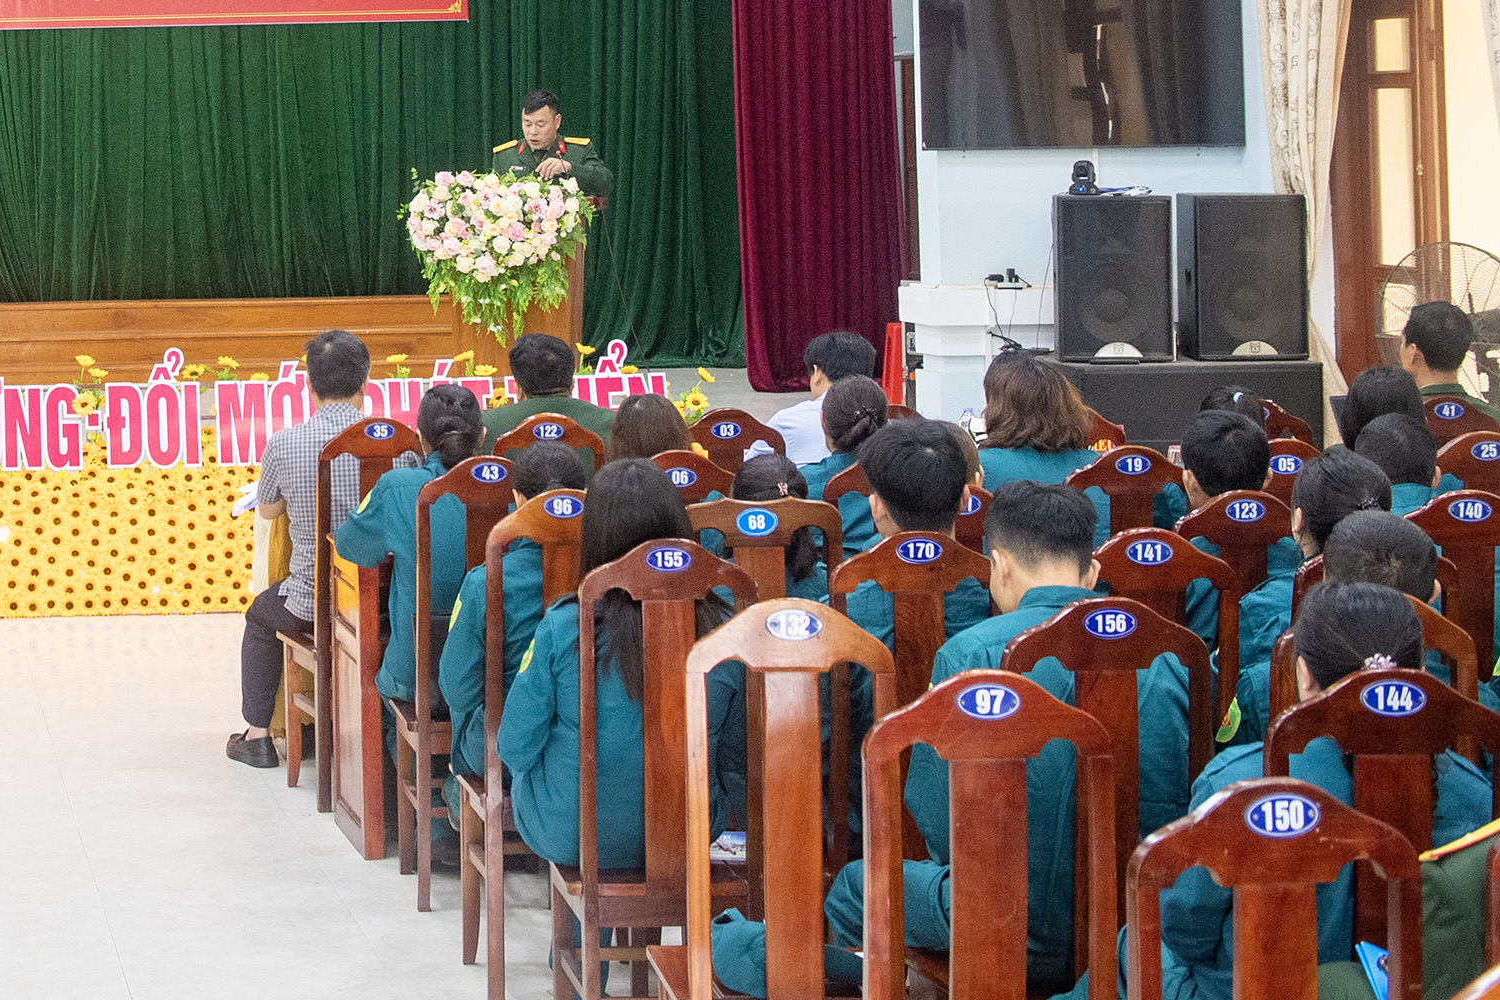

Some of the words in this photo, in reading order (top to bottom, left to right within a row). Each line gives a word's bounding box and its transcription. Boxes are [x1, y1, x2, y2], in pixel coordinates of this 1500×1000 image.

[104, 347, 201, 469] ĐỔI
[1443, 405, 1455, 416] 41
[374, 425, 387, 437] 35
[540, 425, 557, 437] 122
[721, 425, 733, 436] 03
[1482, 444, 1496, 457] 25
[1127, 458, 1142, 471] 19
[1279, 458, 1294, 471] 05
[482, 466, 498, 479] 43
[672, 471, 688, 484] 06
[554, 499, 571, 514] 96
[1234, 503, 1256, 518] 123
[1459, 503, 1482, 518] 140
[749, 515, 765, 529] 68
[908, 543, 934, 558] 170
[1136, 544, 1161, 561] 141
[656, 552, 682, 567] 155
[777, 614, 810, 636] 132
[1096, 615, 1126, 632] 156
[975, 689, 1004, 714] 97
[1376, 687, 1412, 710] 144
[1261, 802, 1304, 832] 150
